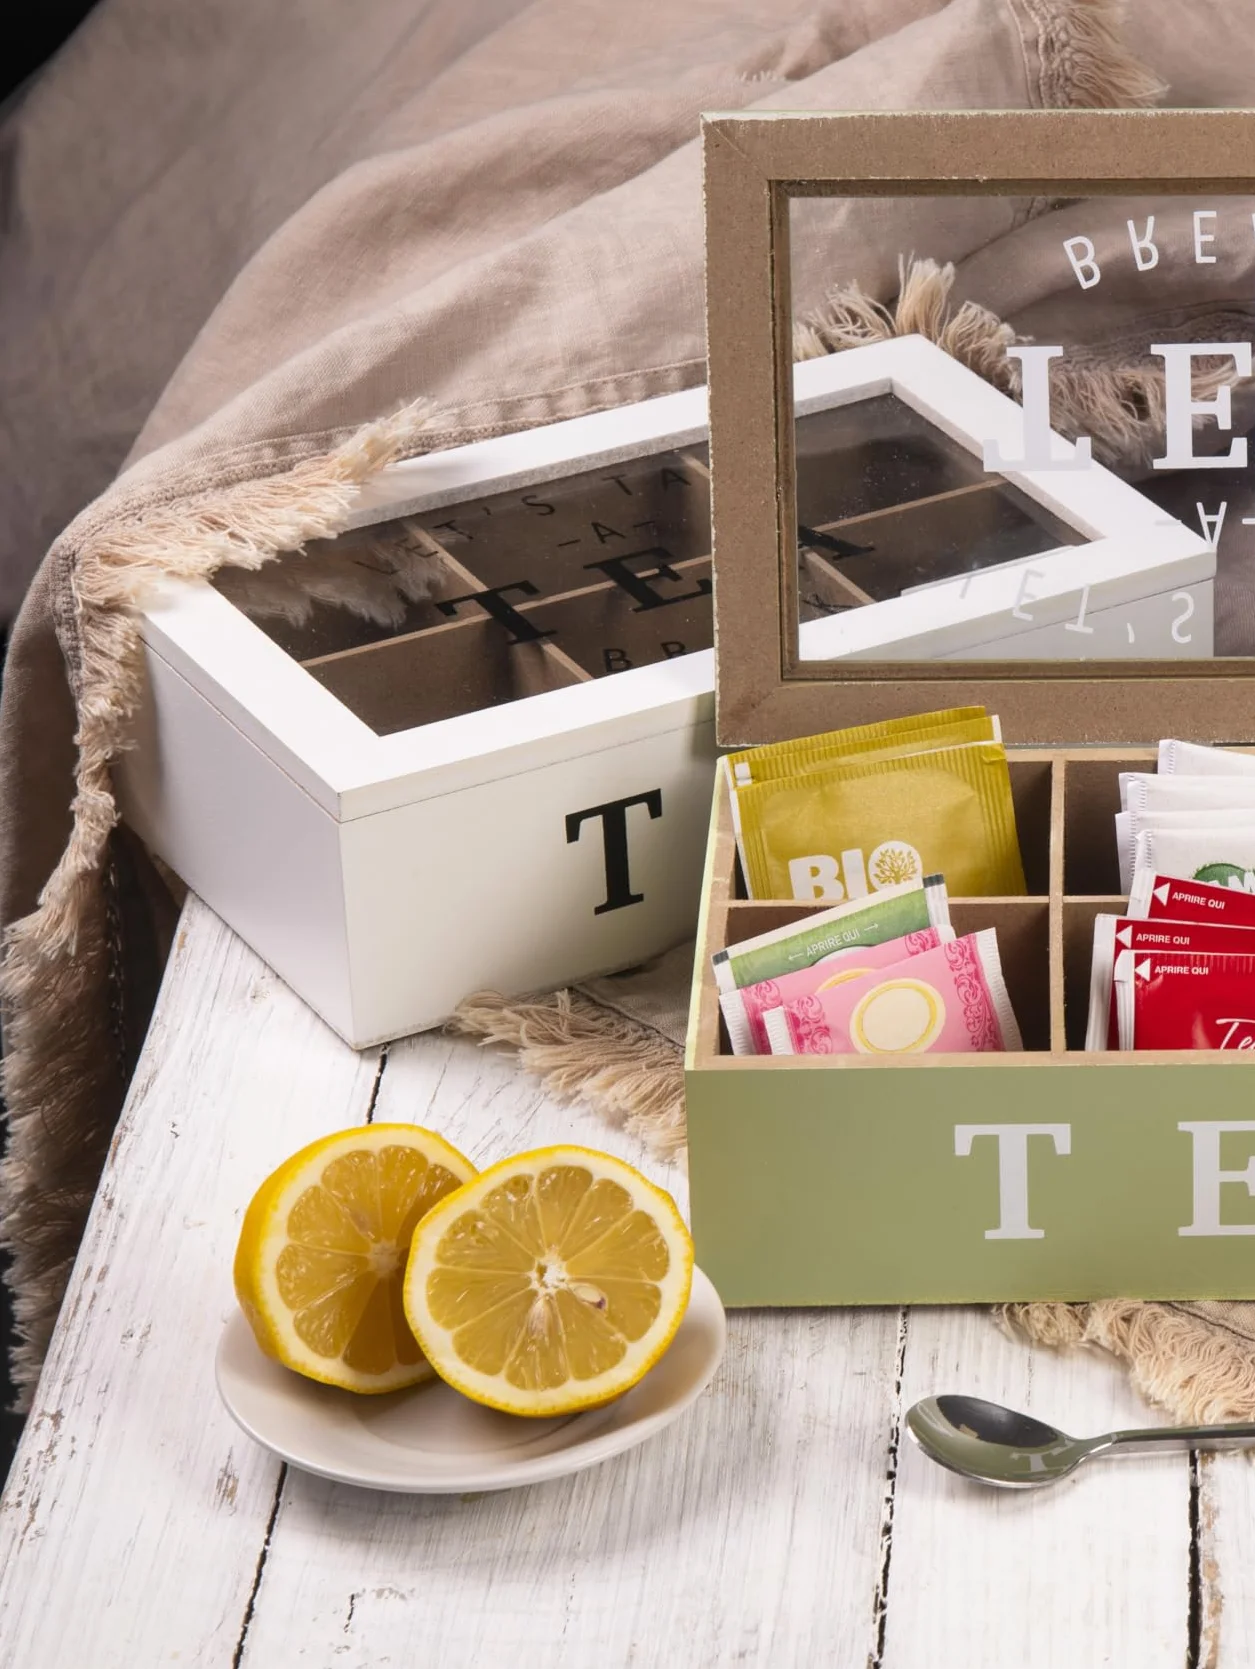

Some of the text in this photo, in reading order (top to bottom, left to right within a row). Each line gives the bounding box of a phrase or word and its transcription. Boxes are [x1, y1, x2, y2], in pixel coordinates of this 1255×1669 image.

[602, 467, 693, 497] TA
[1172, 891, 1225, 910] APRIRE QUI
[806, 929, 861, 957] APRIRE QUI
[1136, 932, 1190, 946] APRIRE QUI
[1154, 965, 1209, 976] APRIRE QUI
